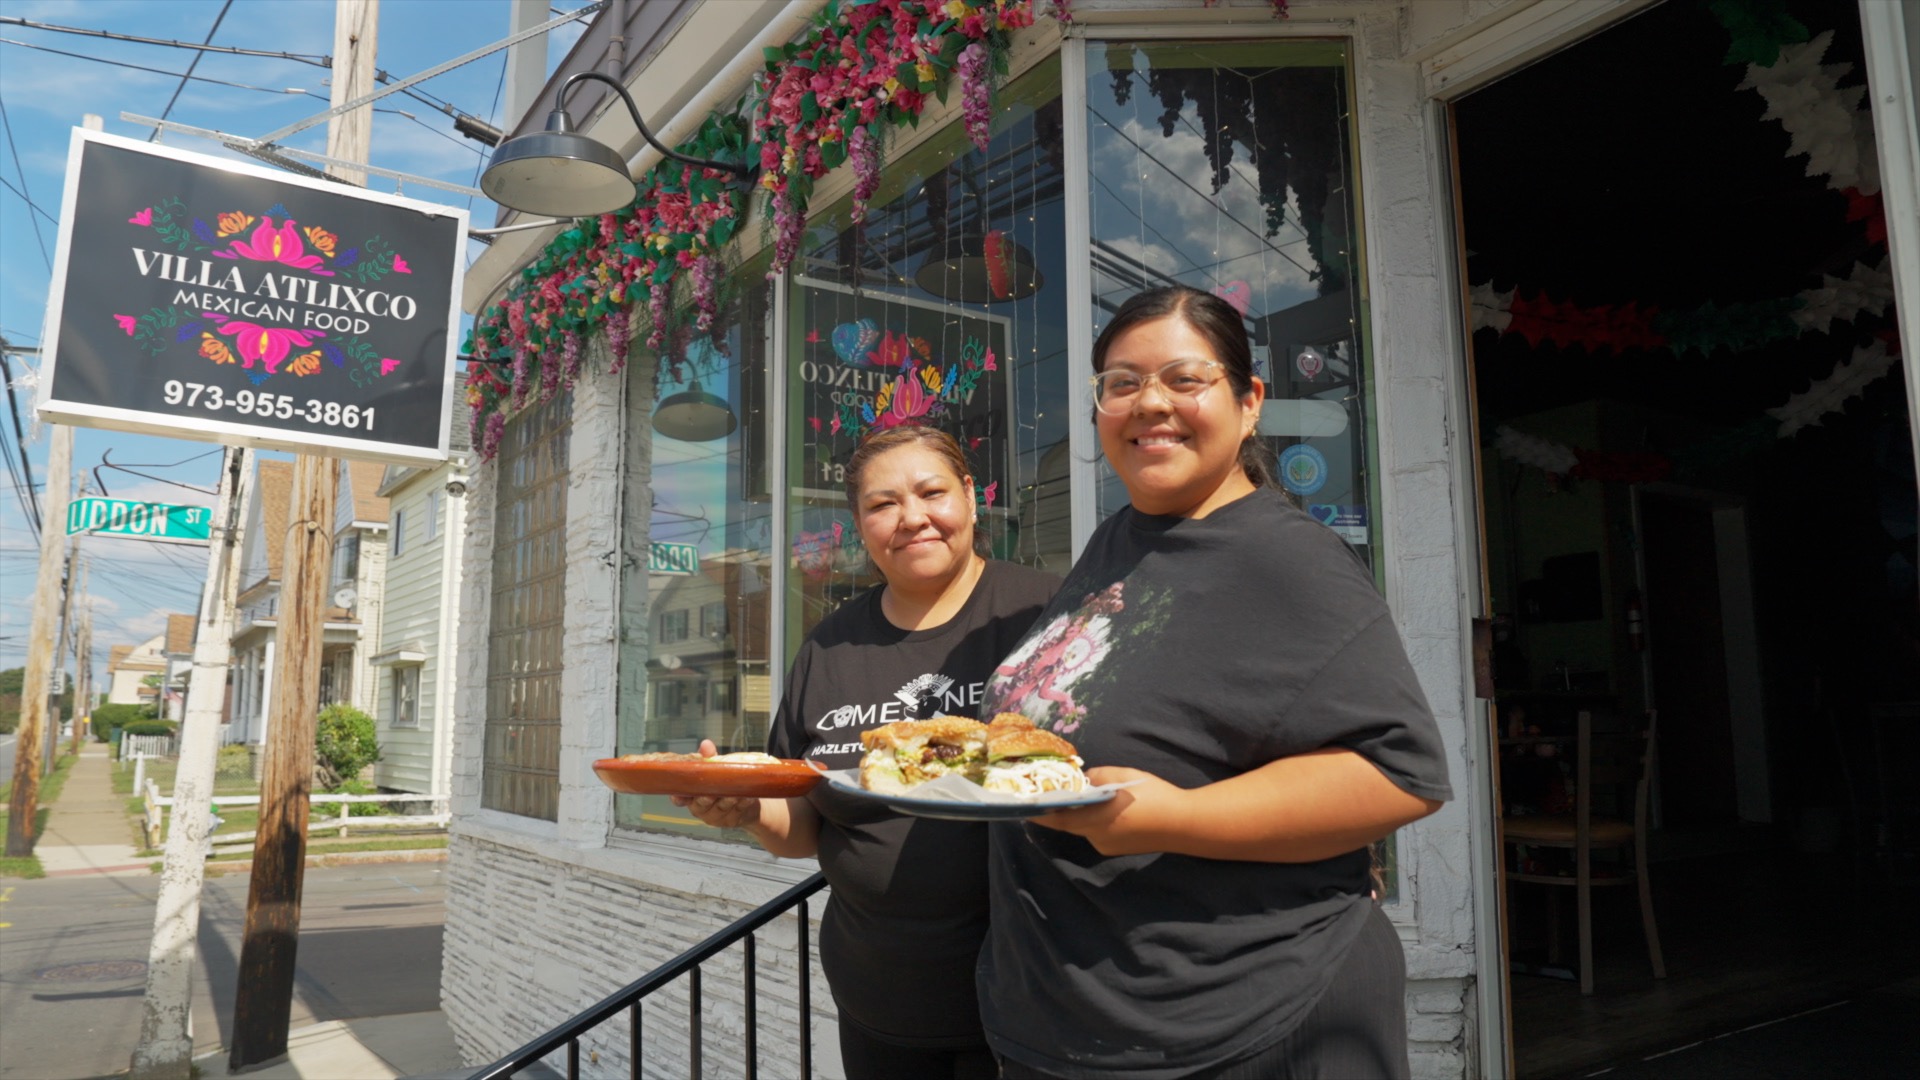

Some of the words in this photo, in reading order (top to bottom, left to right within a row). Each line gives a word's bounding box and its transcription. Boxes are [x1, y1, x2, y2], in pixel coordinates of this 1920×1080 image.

[132, 247, 245, 293] VILLA
[255, 272, 417, 321] ATLIXCO
[173, 289, 294, 324] MEXICAN
[303, 310, 371, 335] FOOD
[163, 379, 374, 431] 973-955-3861
[70, 500, 169, 535] LIDDON
[185, 508, 202, 524] ST
